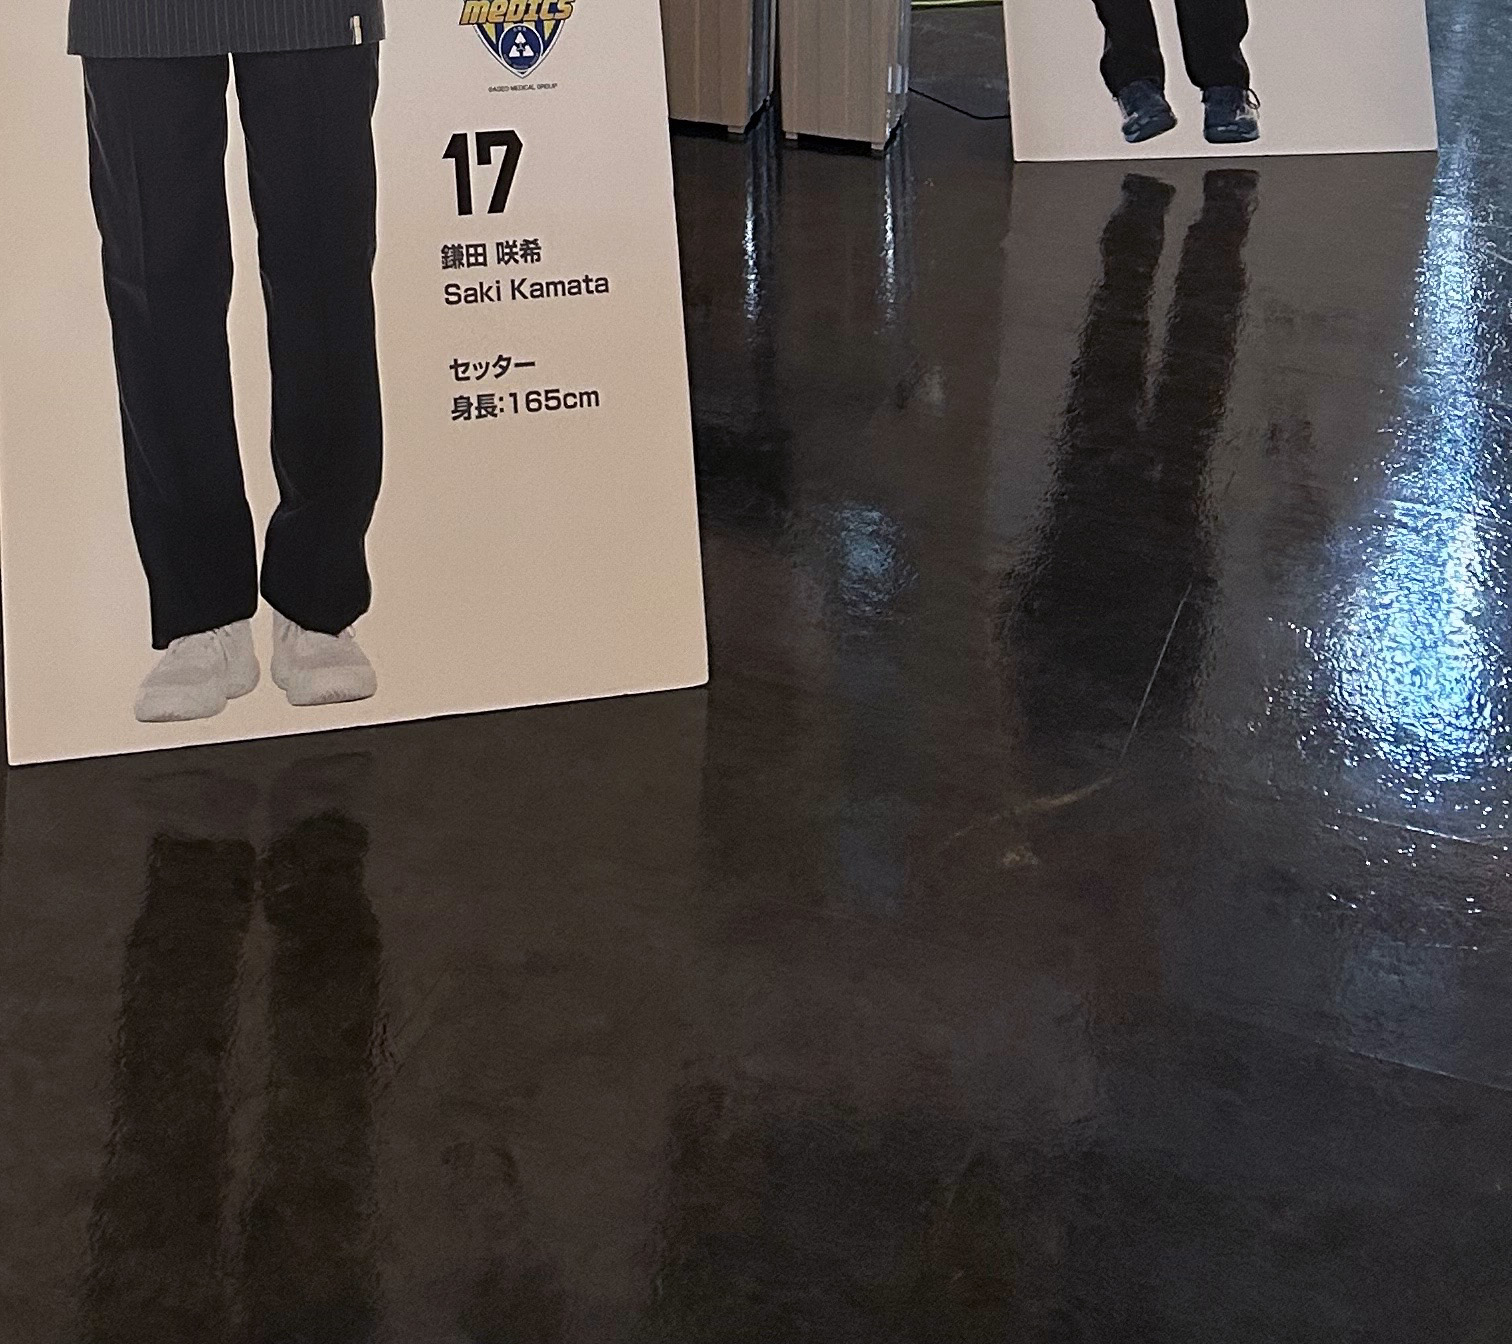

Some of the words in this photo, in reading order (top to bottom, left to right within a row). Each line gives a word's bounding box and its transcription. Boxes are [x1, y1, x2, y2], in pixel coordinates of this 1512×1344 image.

[441, 129, 524, 217] 17
[440, 242, 488, 270] 鎌田
[495, 238, 542, 266] 咲希
[444, 280, 502, 306] Saki
[510, 274, 610, 301] Kamata
[448, 354, 536, 382] セッター
[450, 388, 600, 422] 身長:165cm
